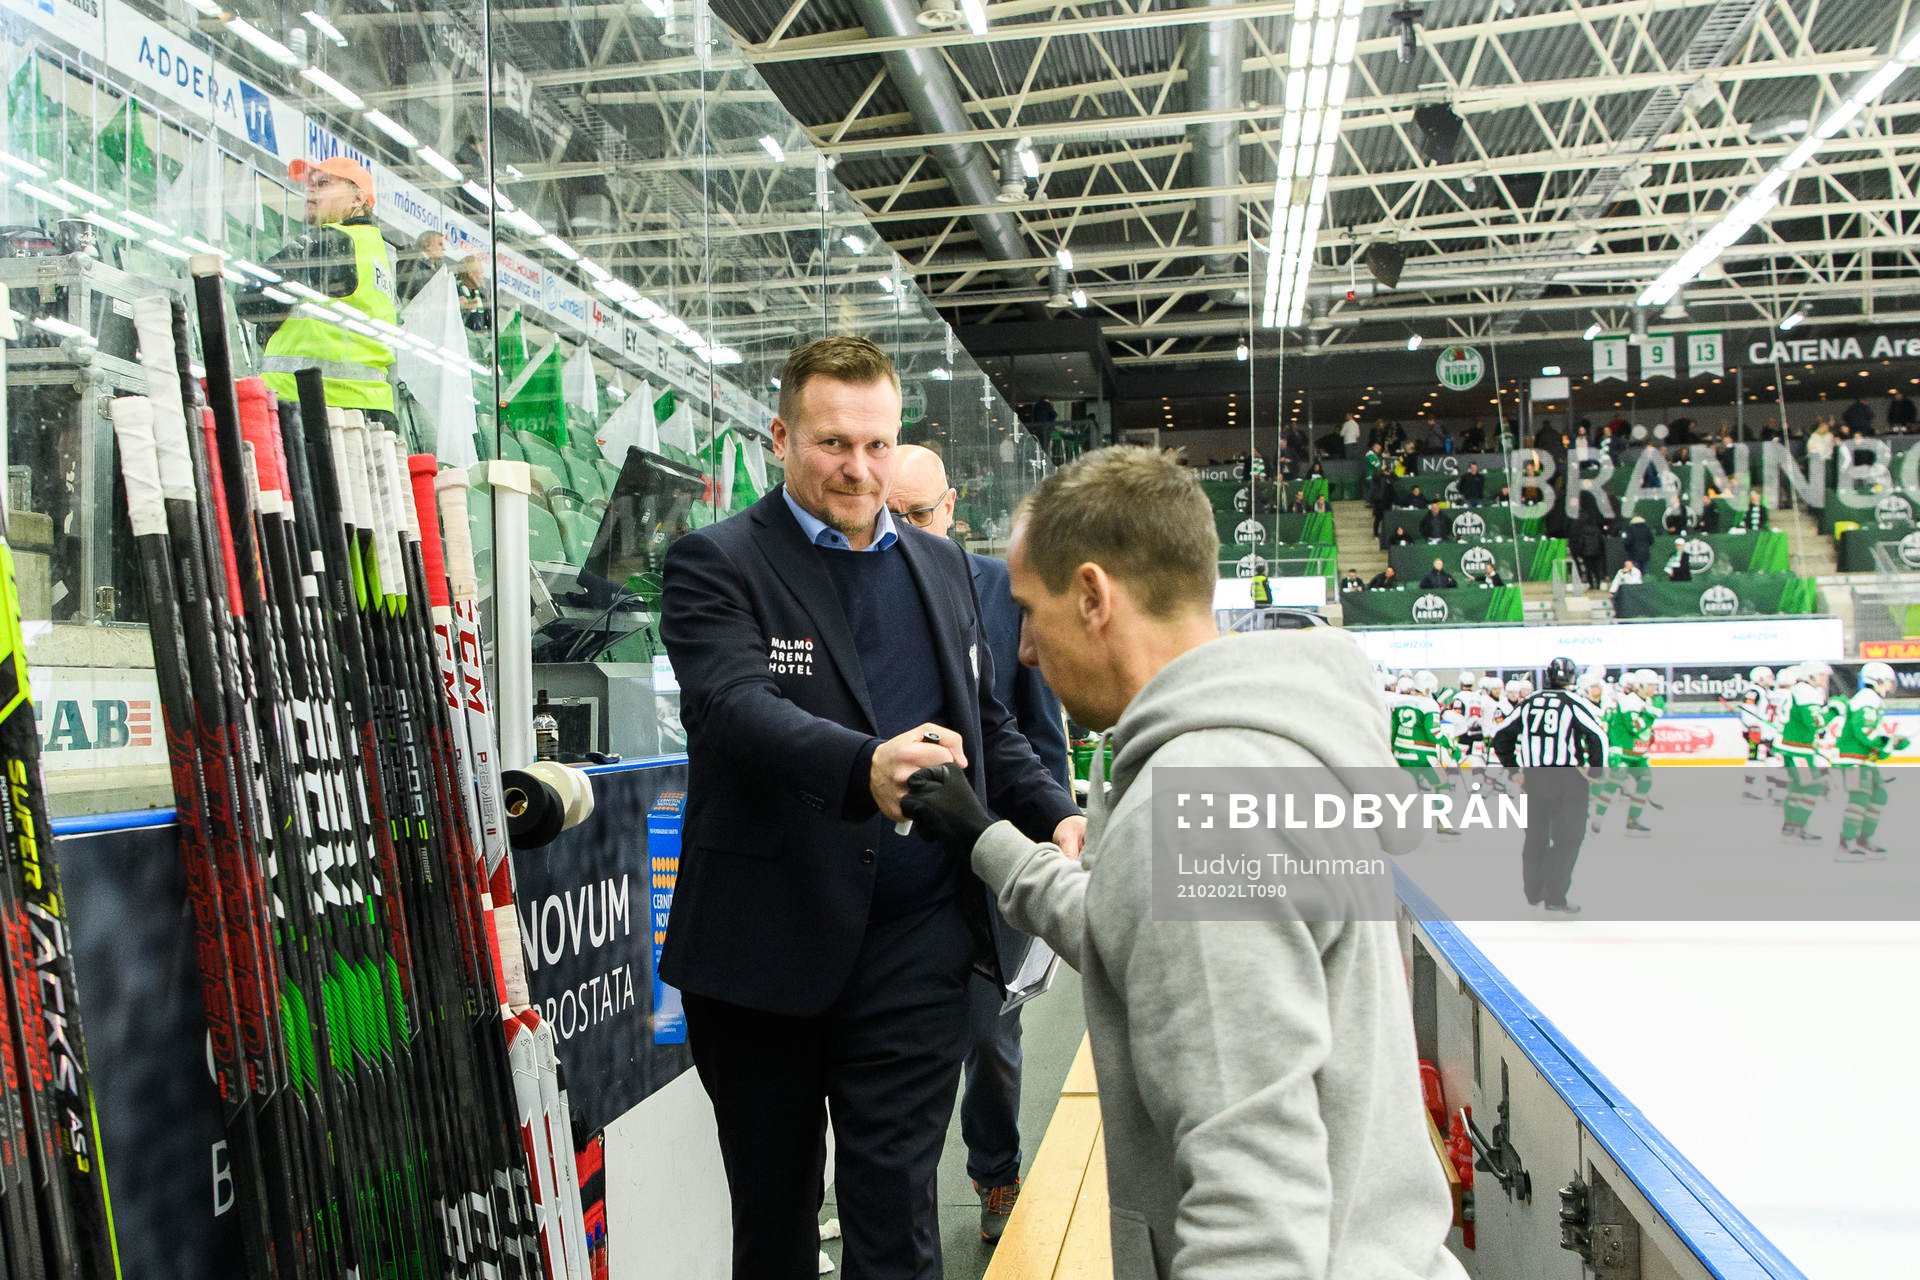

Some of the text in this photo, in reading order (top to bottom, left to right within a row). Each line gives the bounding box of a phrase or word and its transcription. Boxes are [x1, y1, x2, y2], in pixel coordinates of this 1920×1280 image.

[139, 36, 238, 119] ADDERA
[394, 190, 439, 231] månsson
[625, 327, 637, 353] EY
[1696, 343, 1716, 362] 13
[1749, 335, 1862, 365] CATENA
[658, 347, 668, 371] EY
[1606, 348, 1613, 366] 1
[1652, 345, 1664, 364] 9
[1417, 610, 1444, 619] ARENA
[769, 650, 813, 663] ARENA
[771, 637, 814, 651] MALMÖ
[769, 662, 813, 675] HOTEL
[1529, 708, 1559, 734] 79
[477, 751, 496, 828] PREMIER
[7, 758, 43, 890] SUPER
[519, 873, 630, 972] NOVUM
[26, 890, 91, 1174] TACKS AS3
